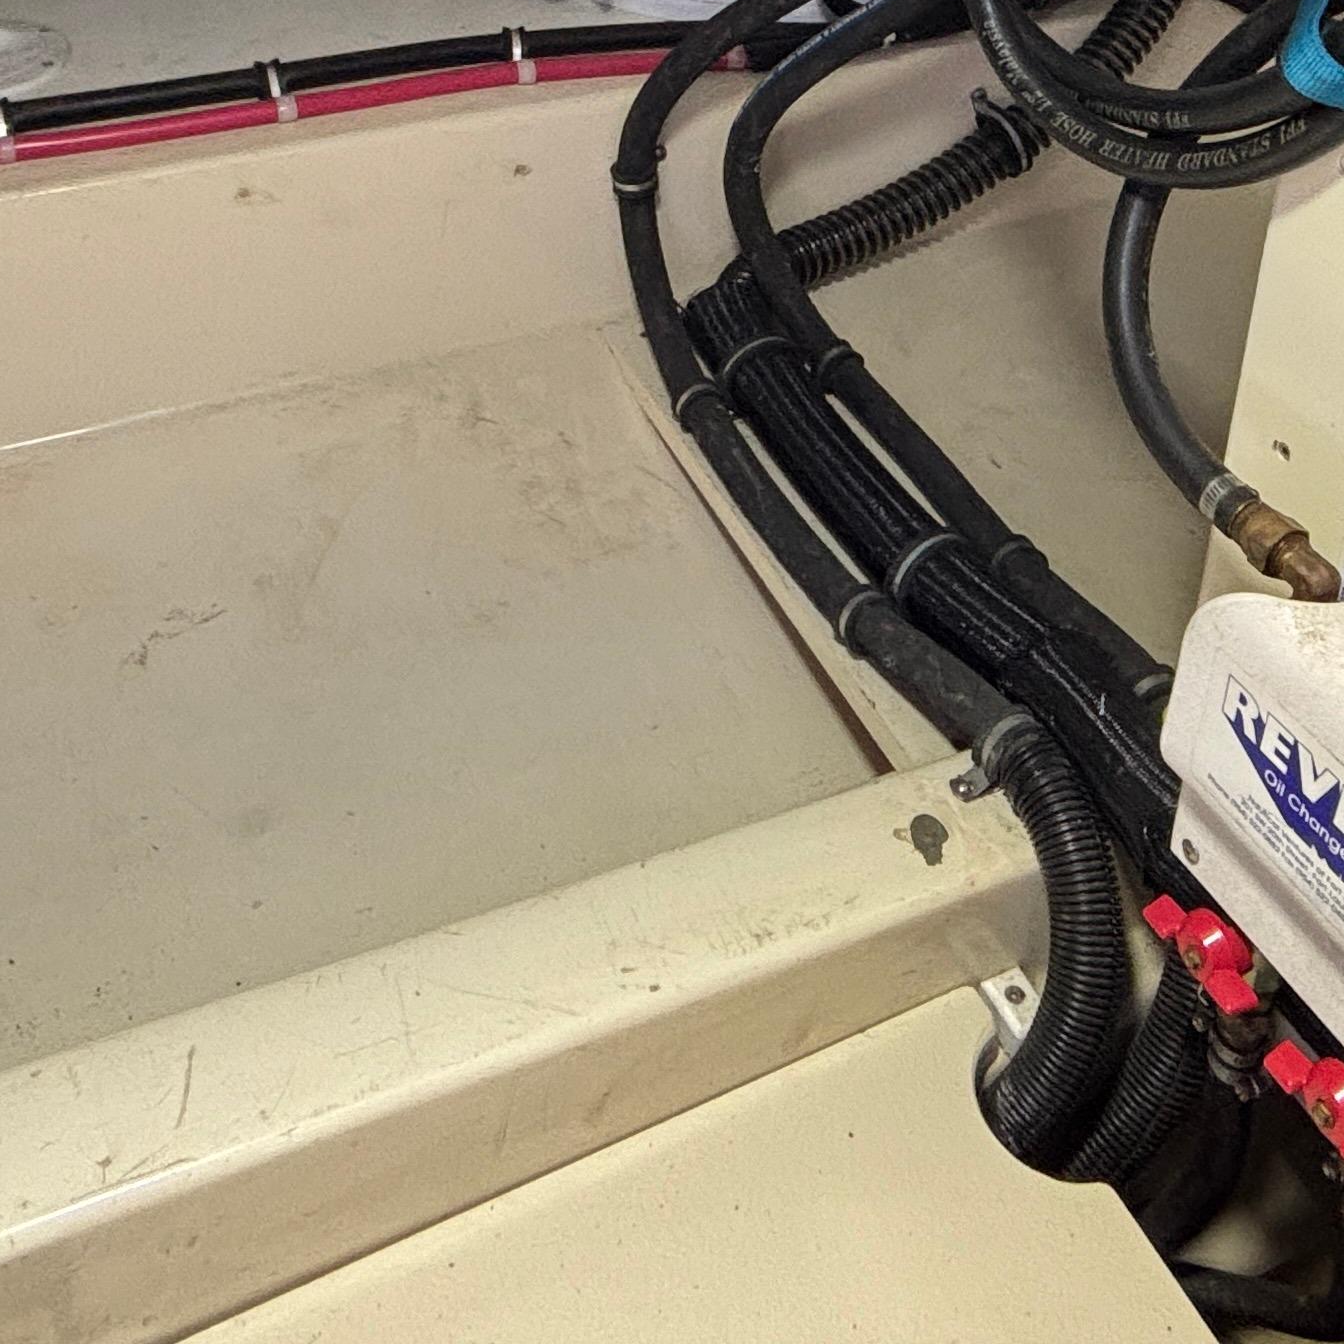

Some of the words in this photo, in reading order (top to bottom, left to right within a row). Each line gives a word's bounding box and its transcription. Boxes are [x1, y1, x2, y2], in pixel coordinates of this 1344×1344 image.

[1050, 110, 1098, 148] HOSE
[1098, 137, 1170, 171] HEATER
[1177, 128, 1271, 171] STANDARD
[1263, 768, 1287, 798] Oil
